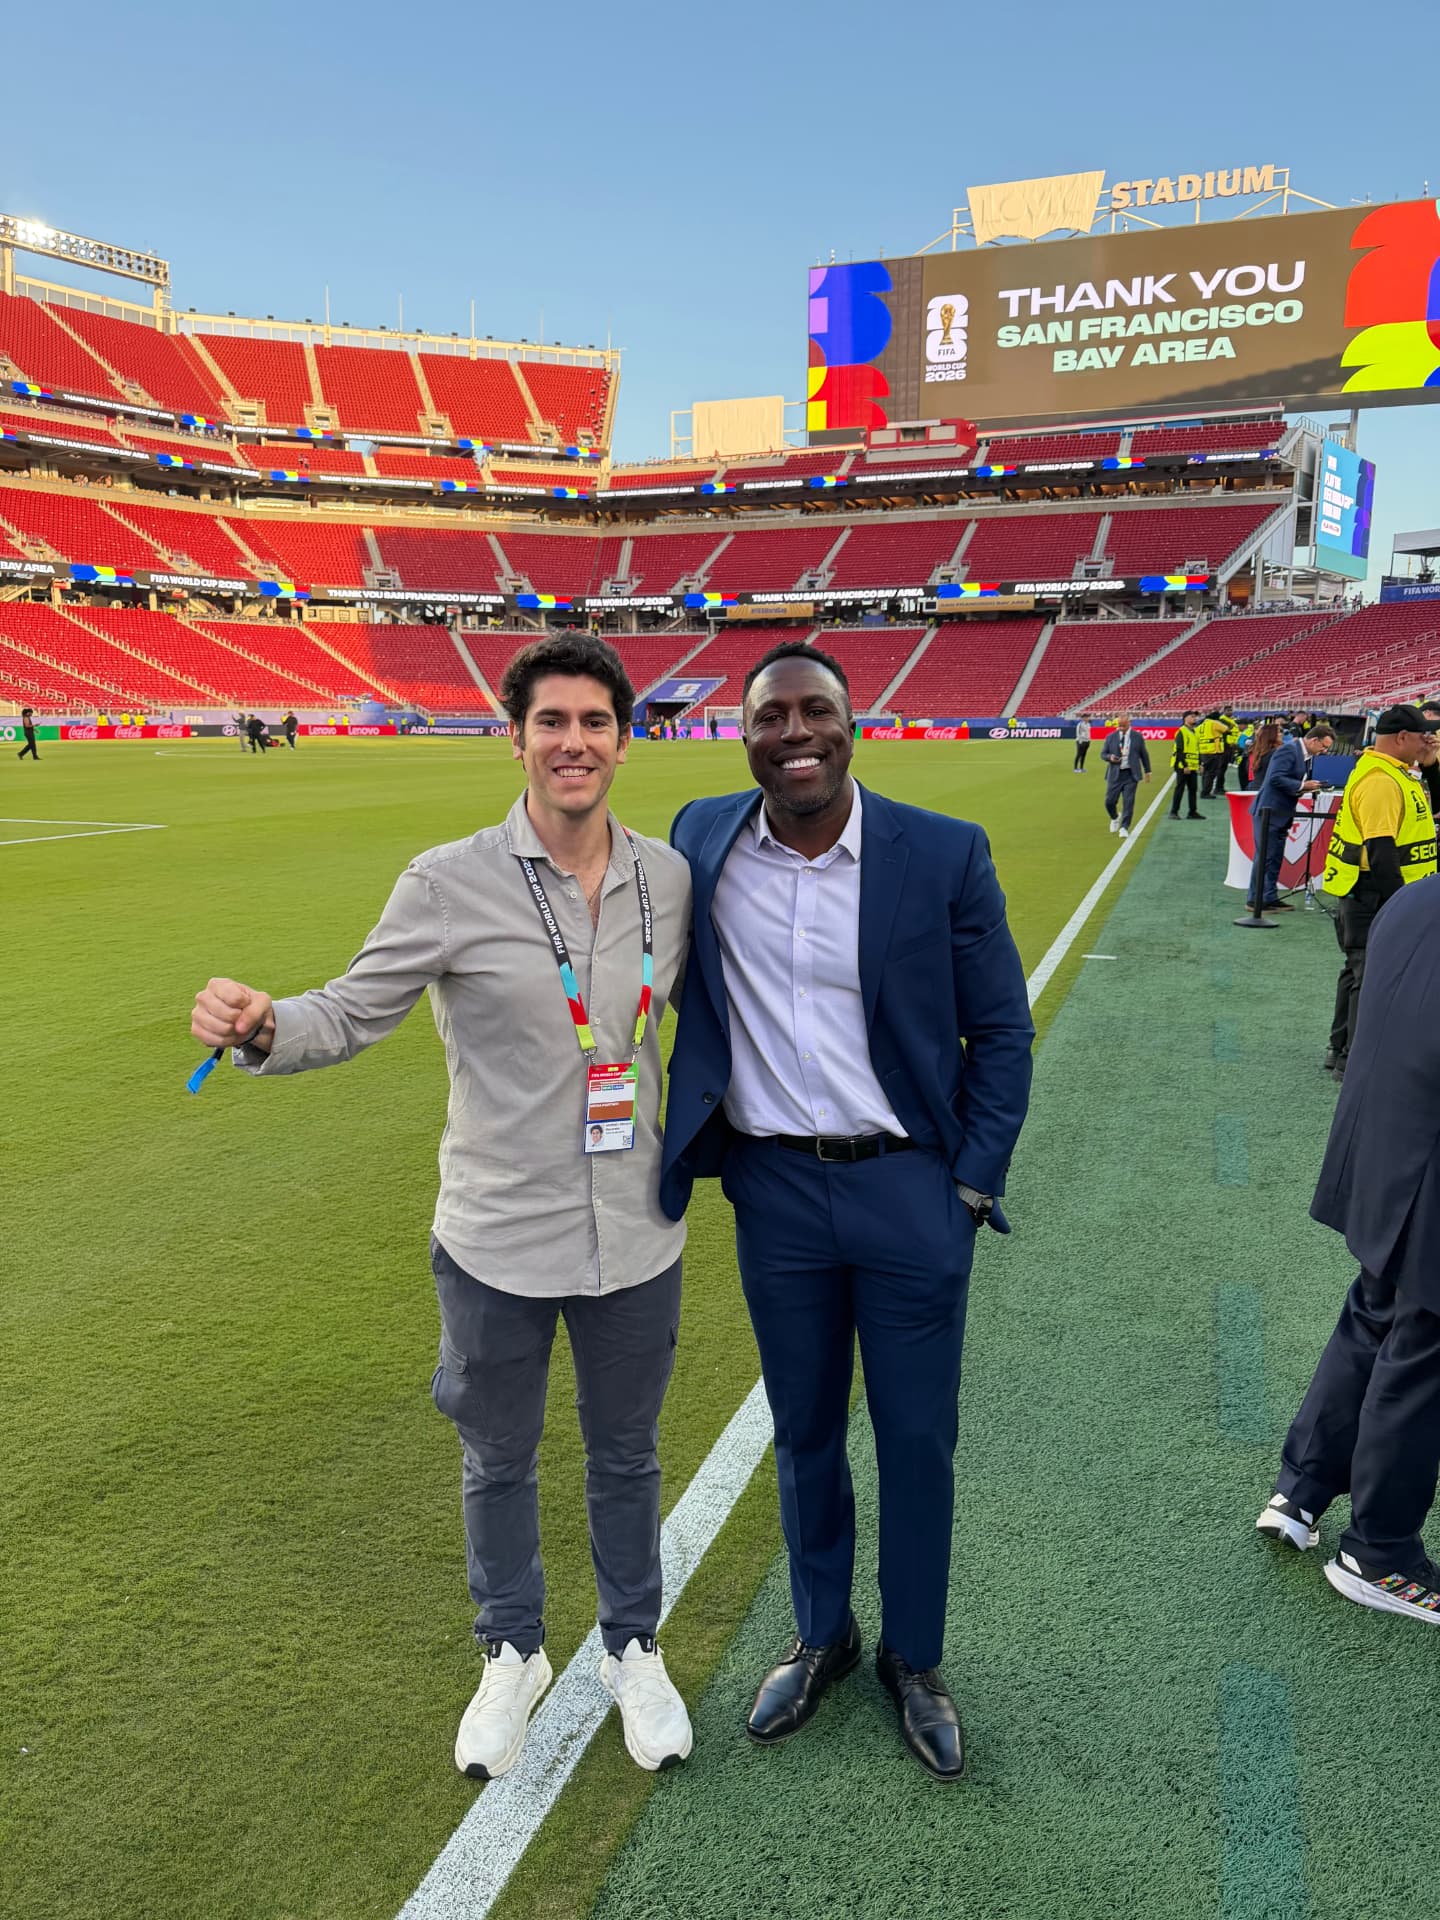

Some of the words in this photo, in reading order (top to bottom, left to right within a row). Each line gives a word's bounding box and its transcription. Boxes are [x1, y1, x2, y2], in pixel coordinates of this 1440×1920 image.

[1112, 164, 1274, 209] STADIUM
[998, 274, 1177, 318] THANK
[1188, 261, 1306, 298] YOU
[997, 320, 1072, 348] SAN
[1079, 300, 1303, 340] FRANCISCO
[938, 348, 956, 356] FIFA
[1053, 345, 1125, 372] BAY
[1130, 337, 1236, 364] AREA
[926, 363, 951, 372] WORLD
[925, 370, 966, 382] 2026
[0, 561, 22, 570] BAY
[24, 564, 55, 574] AREA
[150, 574, 170, 583] FIFA
[170, 576, 200, 586] WORLD
[201, 578, 218, 588] CUP
[1014, 584, 1035, 592] FIFA
[1035, 582, 1069, 592] WORLD
[1069, 581, 1090, 590] CUP
[327, 589, 362, 598] THANK
[363, 590, 384, 599] YOU
[752, 594, 783, 602] THANK
[784, 592, 803, 601] YOU
[1403, 587, 1421, 595] FIFA
[585, 598, 602, 606] FIFA
[602, 598, 629, 606] WORLD
[629, 597, 645, 606] CUP
[348, 725, 380, 736] Lenovo
[410, 726, 428, 734] ADI
[1010, 729, 1062, 738] HYUNDAI
[637, 860, 647, 891] WORLD
[532, 884, 545, 901] CUP
[641, 892, 650, 910] CUP
[540, 901, 558, 934] WORLD
[552, 934, 565, 954] FIFA
